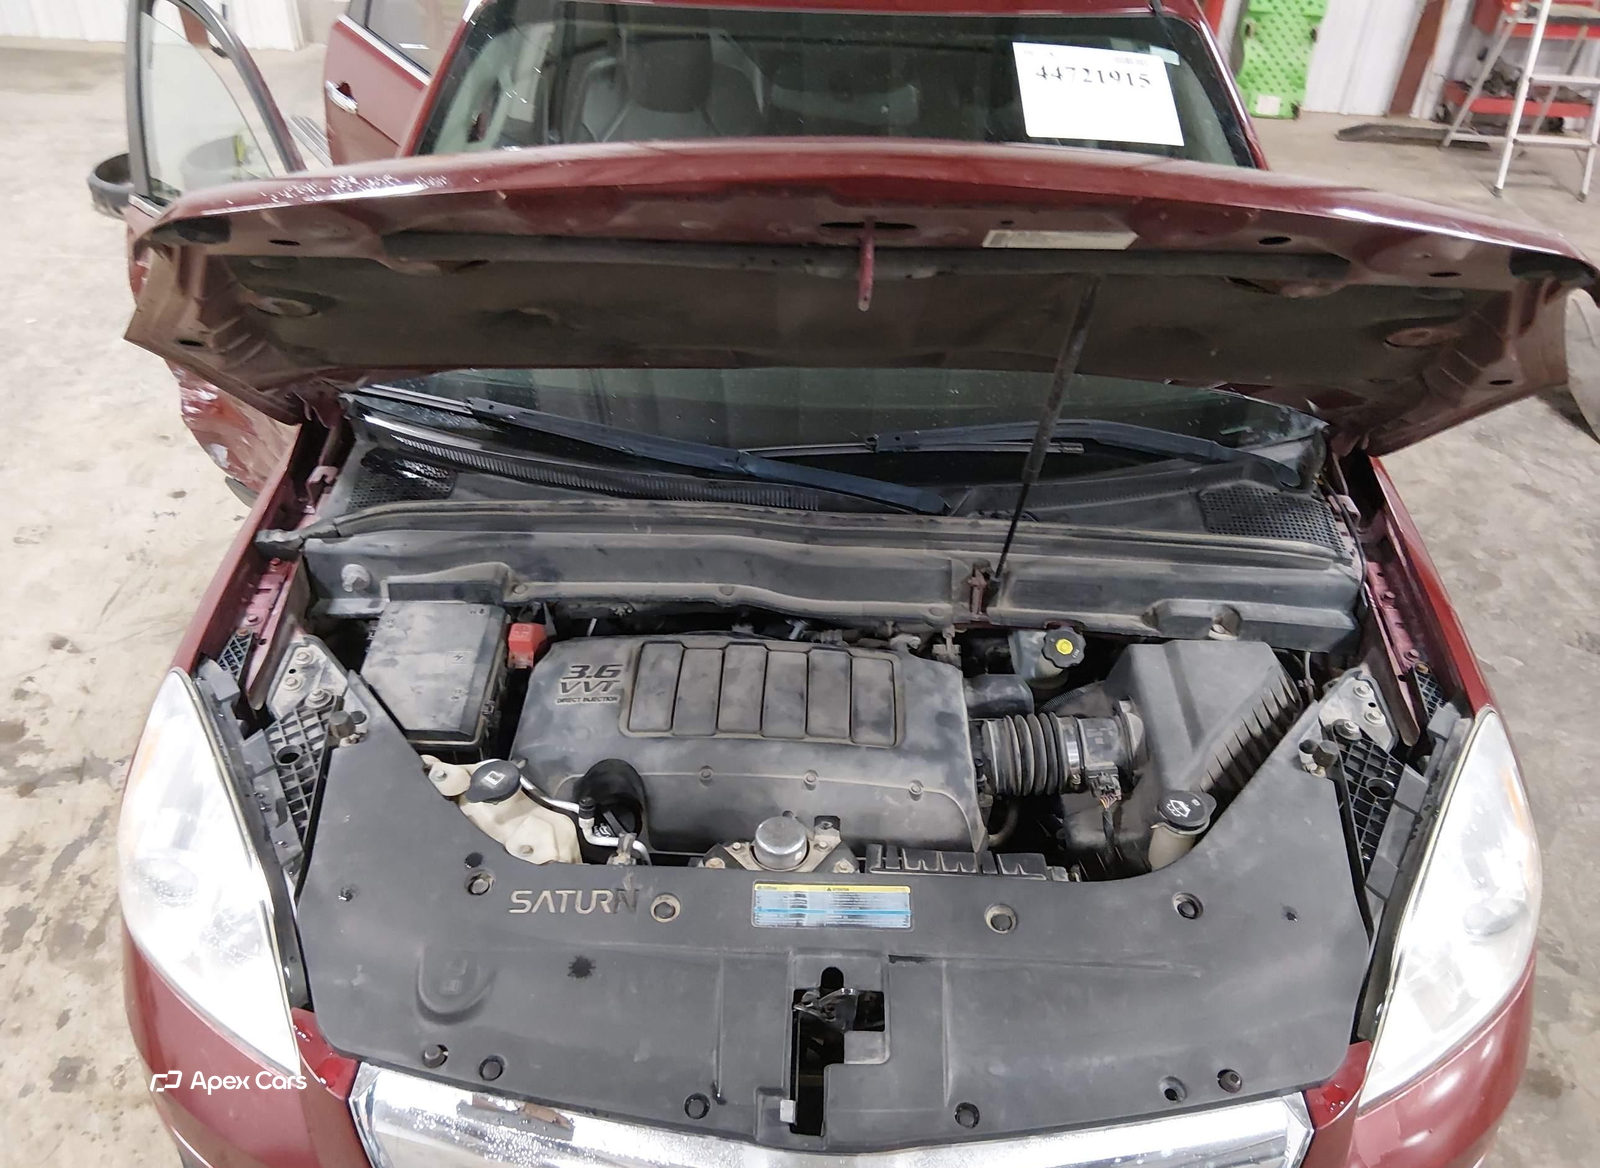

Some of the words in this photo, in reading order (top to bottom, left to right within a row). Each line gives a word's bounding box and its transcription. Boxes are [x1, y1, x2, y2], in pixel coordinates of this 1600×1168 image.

[1036, 65, 1151, 88] 44721915
[561, 664, 623, 680] 3.6
[560, 680, 621, 694] VVT
[508, 888, 640, 914] SATURN
